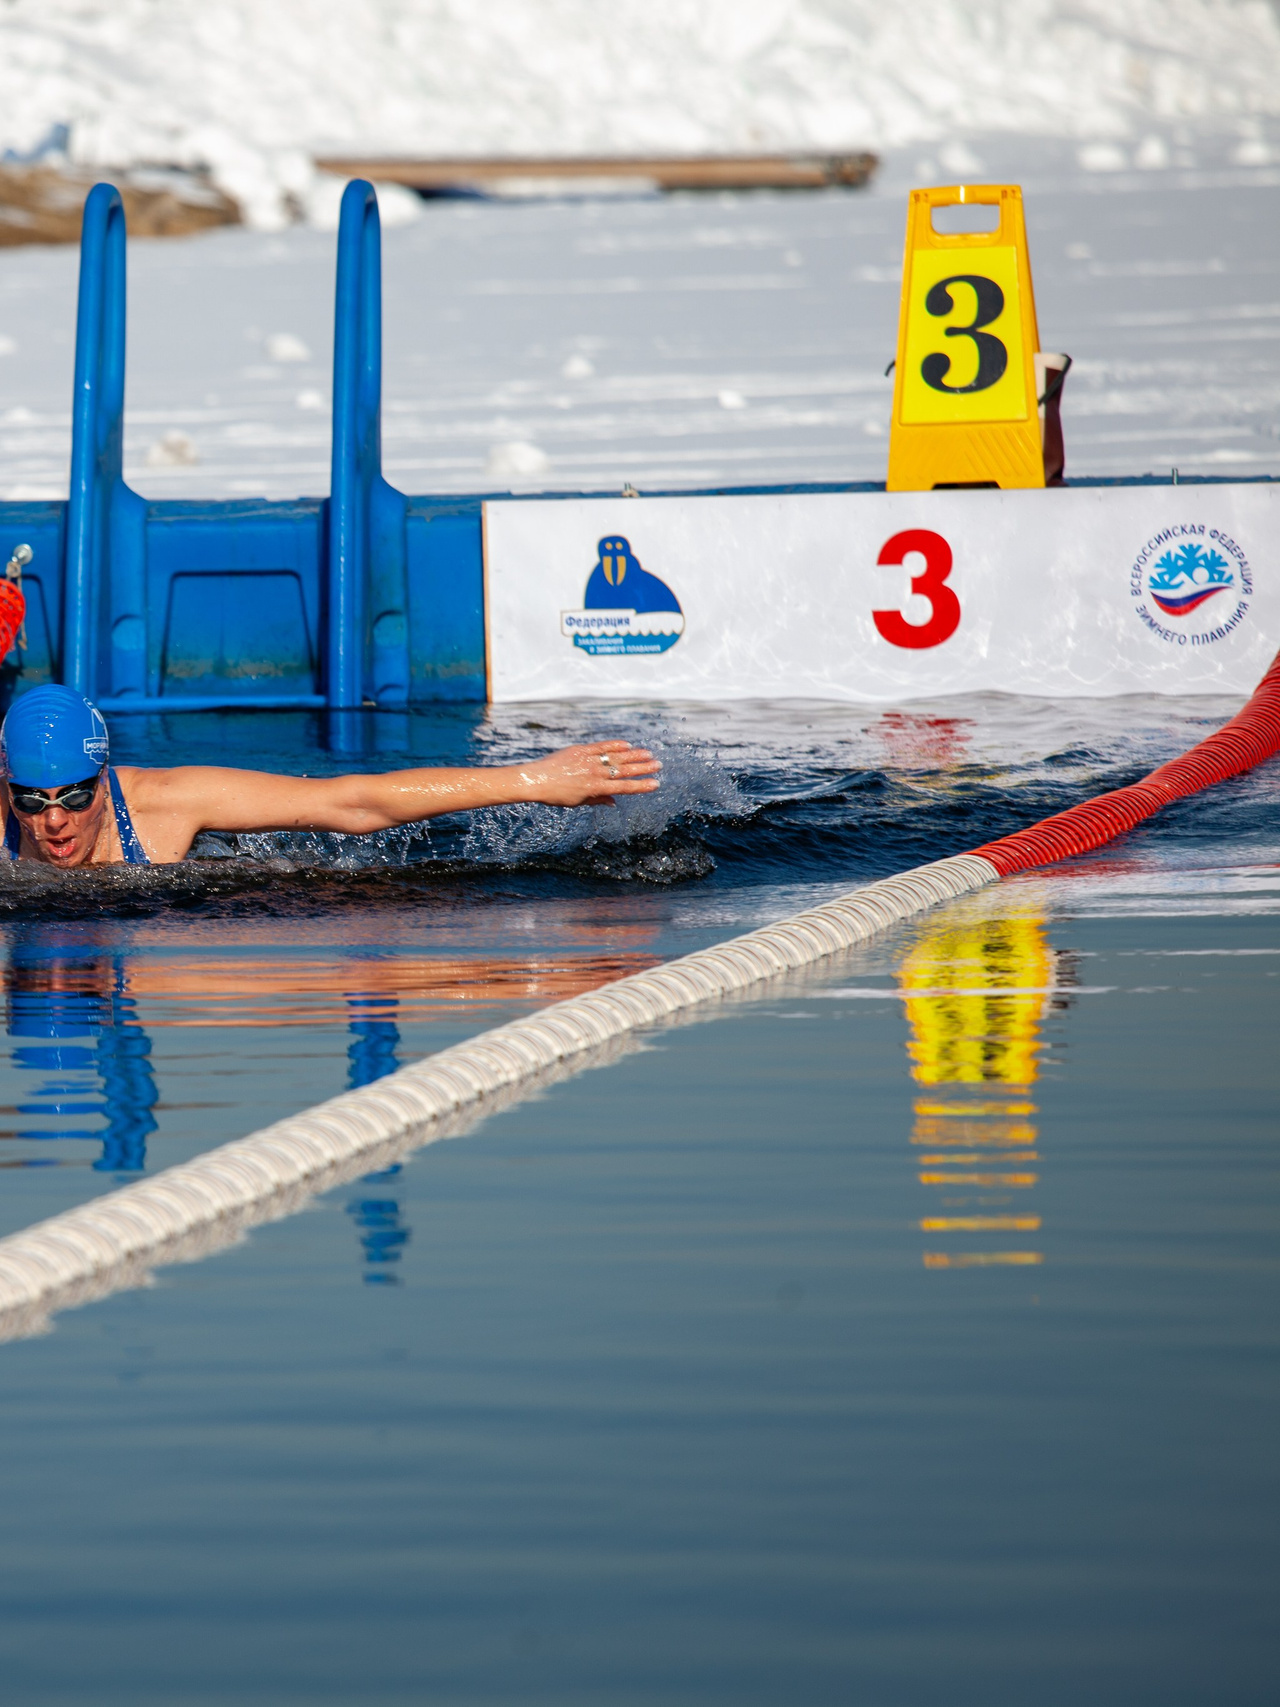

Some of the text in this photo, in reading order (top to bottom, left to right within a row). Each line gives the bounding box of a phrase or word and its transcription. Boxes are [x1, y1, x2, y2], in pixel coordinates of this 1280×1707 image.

[922, 274, 1008, 394] 3
[872, 528, 961, 650] 3
[1130, 523, 1254, 597] ВСЕРОССИЙСКАЯ ФЕДЕРАЦИЯ
[565, 615, 630, 630] Федерация
[1135, 600, 1250, 647] ЗИМНЕГО ПЛАВАНИЯ
